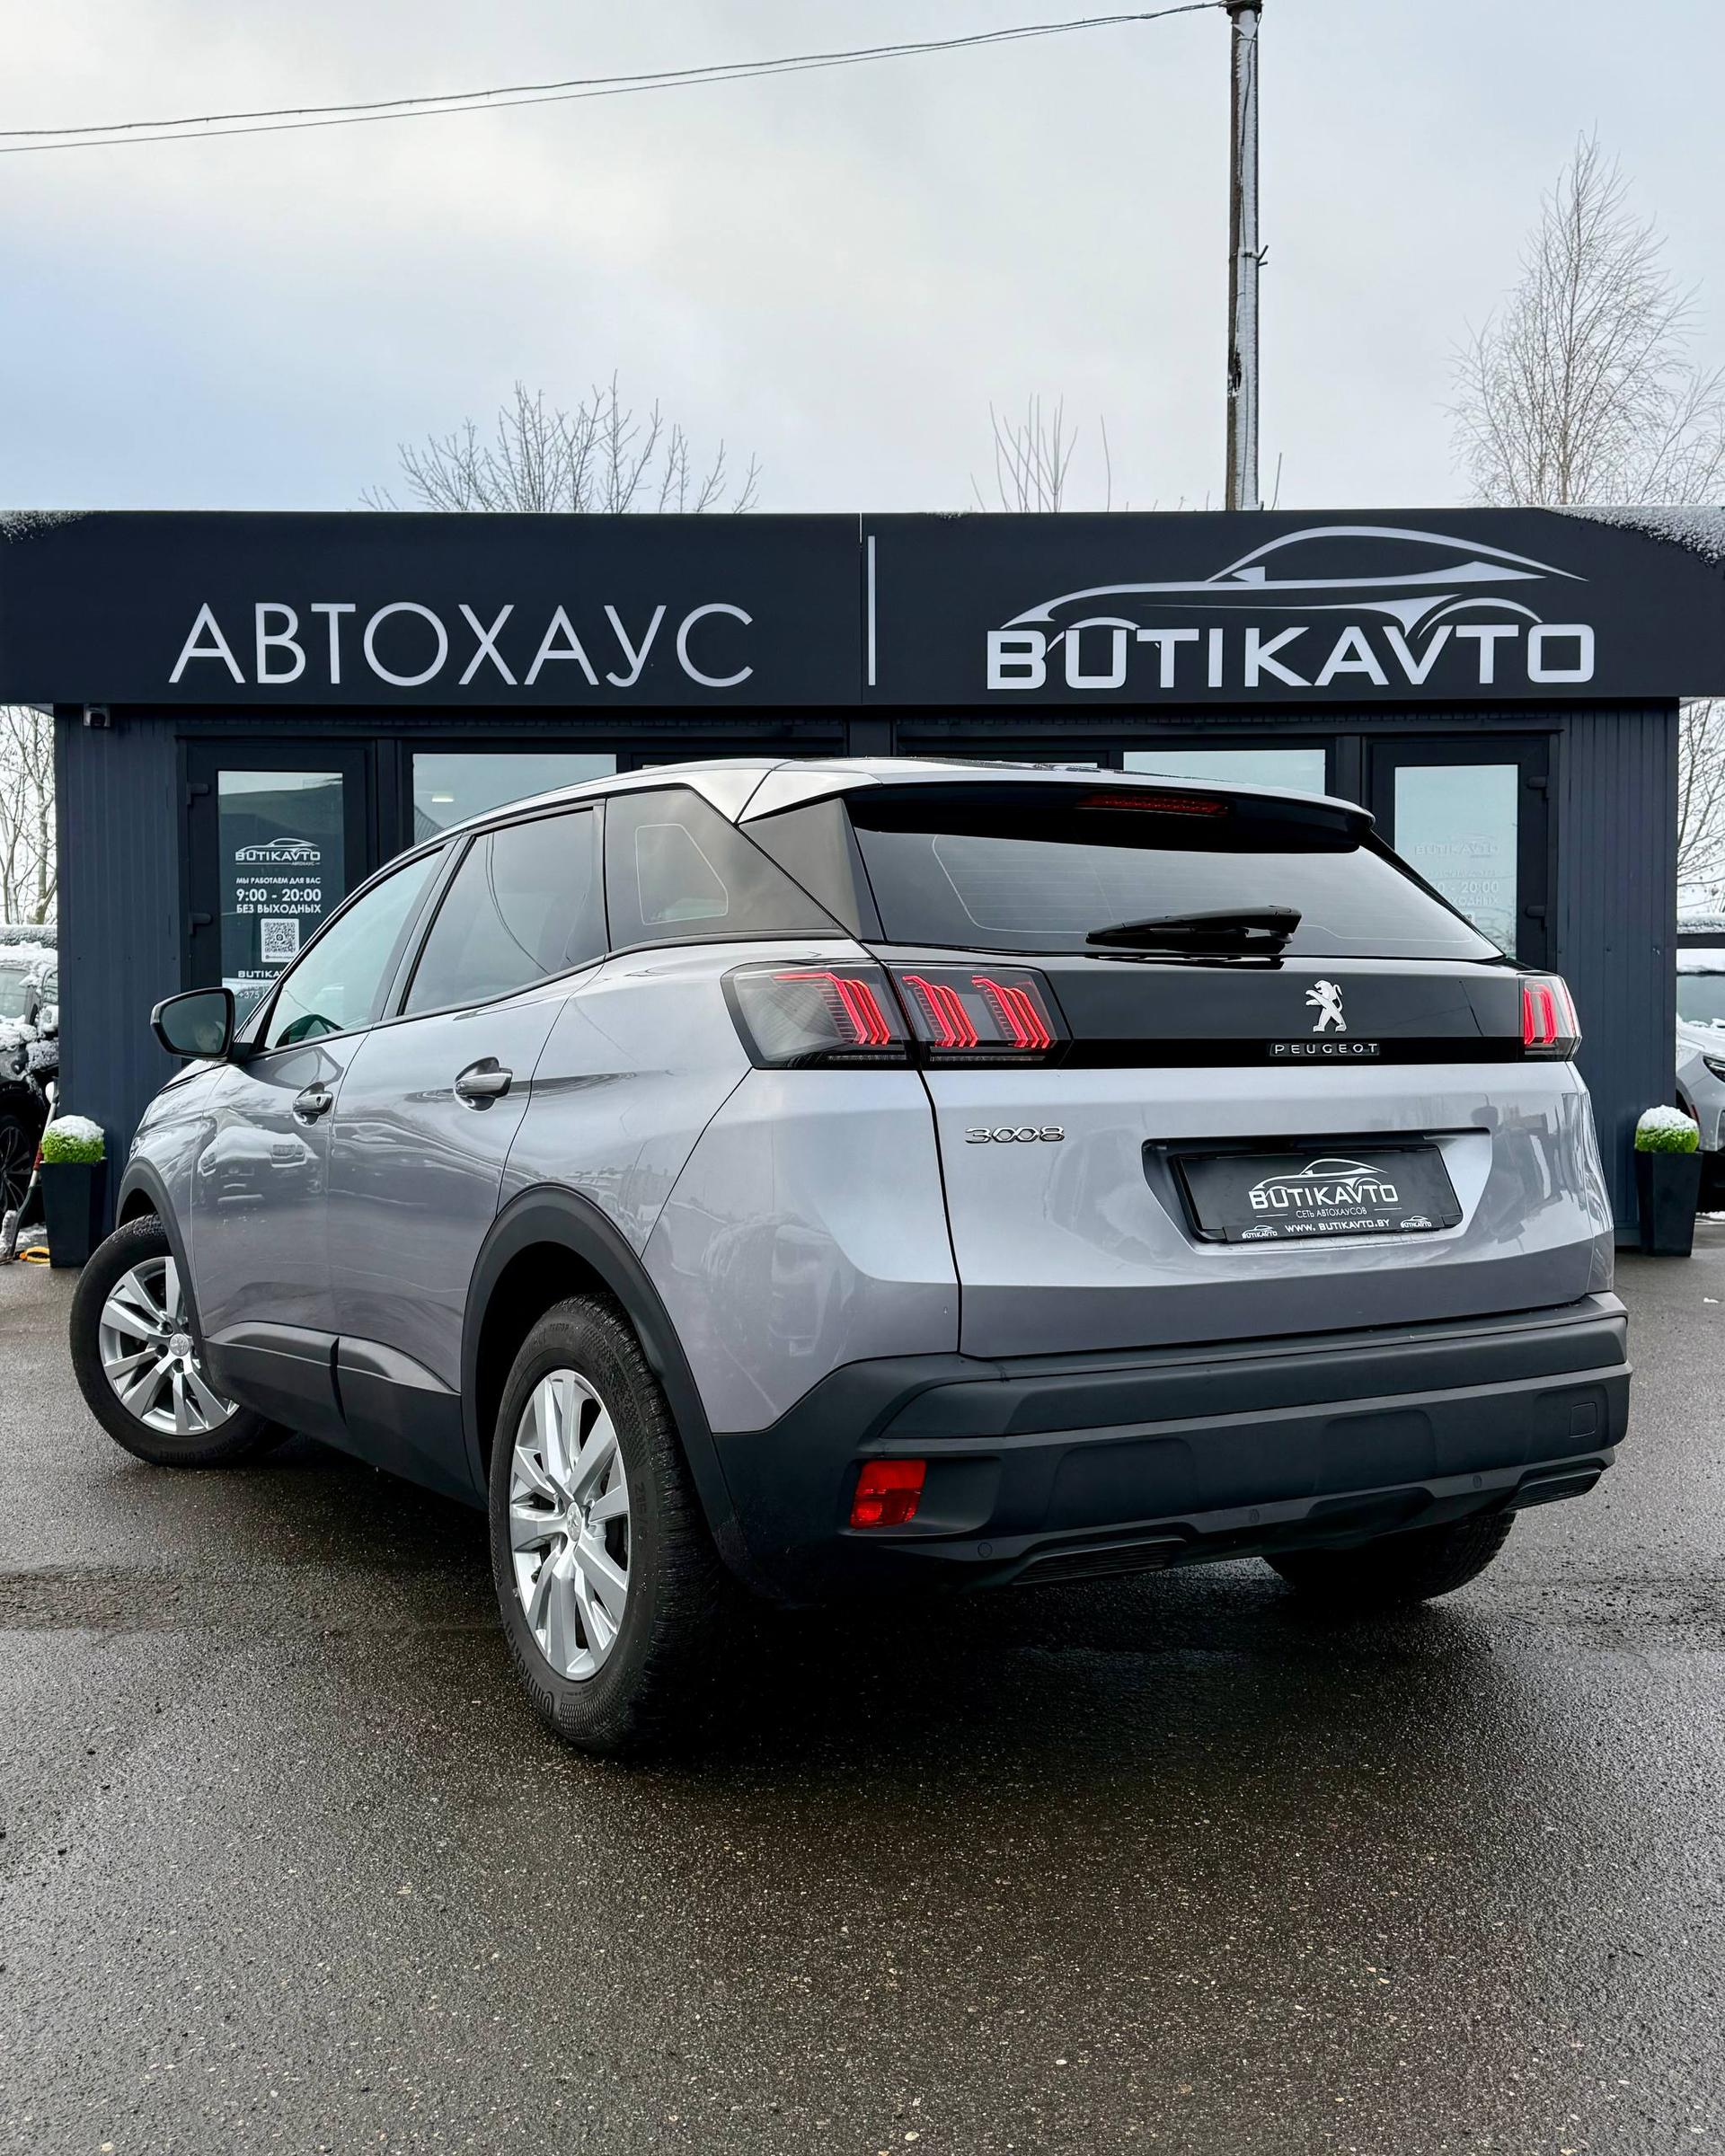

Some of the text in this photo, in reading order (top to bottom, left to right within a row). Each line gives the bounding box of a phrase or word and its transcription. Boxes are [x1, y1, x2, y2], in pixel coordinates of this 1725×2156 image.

[168, 602, 754, 688] АВТОХАУС
[986, 623, 1595, 690] BUTIKAVTO
[234, 851, 321, 862] BUTIKAVTO
[235, 877, 322, 885] МЫ РАБОТАЕМ ДЛЯ ВАС
[236, 888, 267, 902] 9:00
[281, 888, 322, 902] 20:00
[236, 904, 322, 915] БЕЗ ВЫХОДНЫХ
[237, 970, 283, 978] BUTIKA
[1274, 1043, 1378, 1055] PEUGEOT
[965, 1126, 1066, 1144] 3008
[1248, 1183, 1399, 1210] BUTIKAVTO
[1296, 1206, 1367, 1218] СЕТЬ АВТОХАУСОВ
[1284, 1219, 1390, 1233] WWW. BUTIKAVTO.BY
